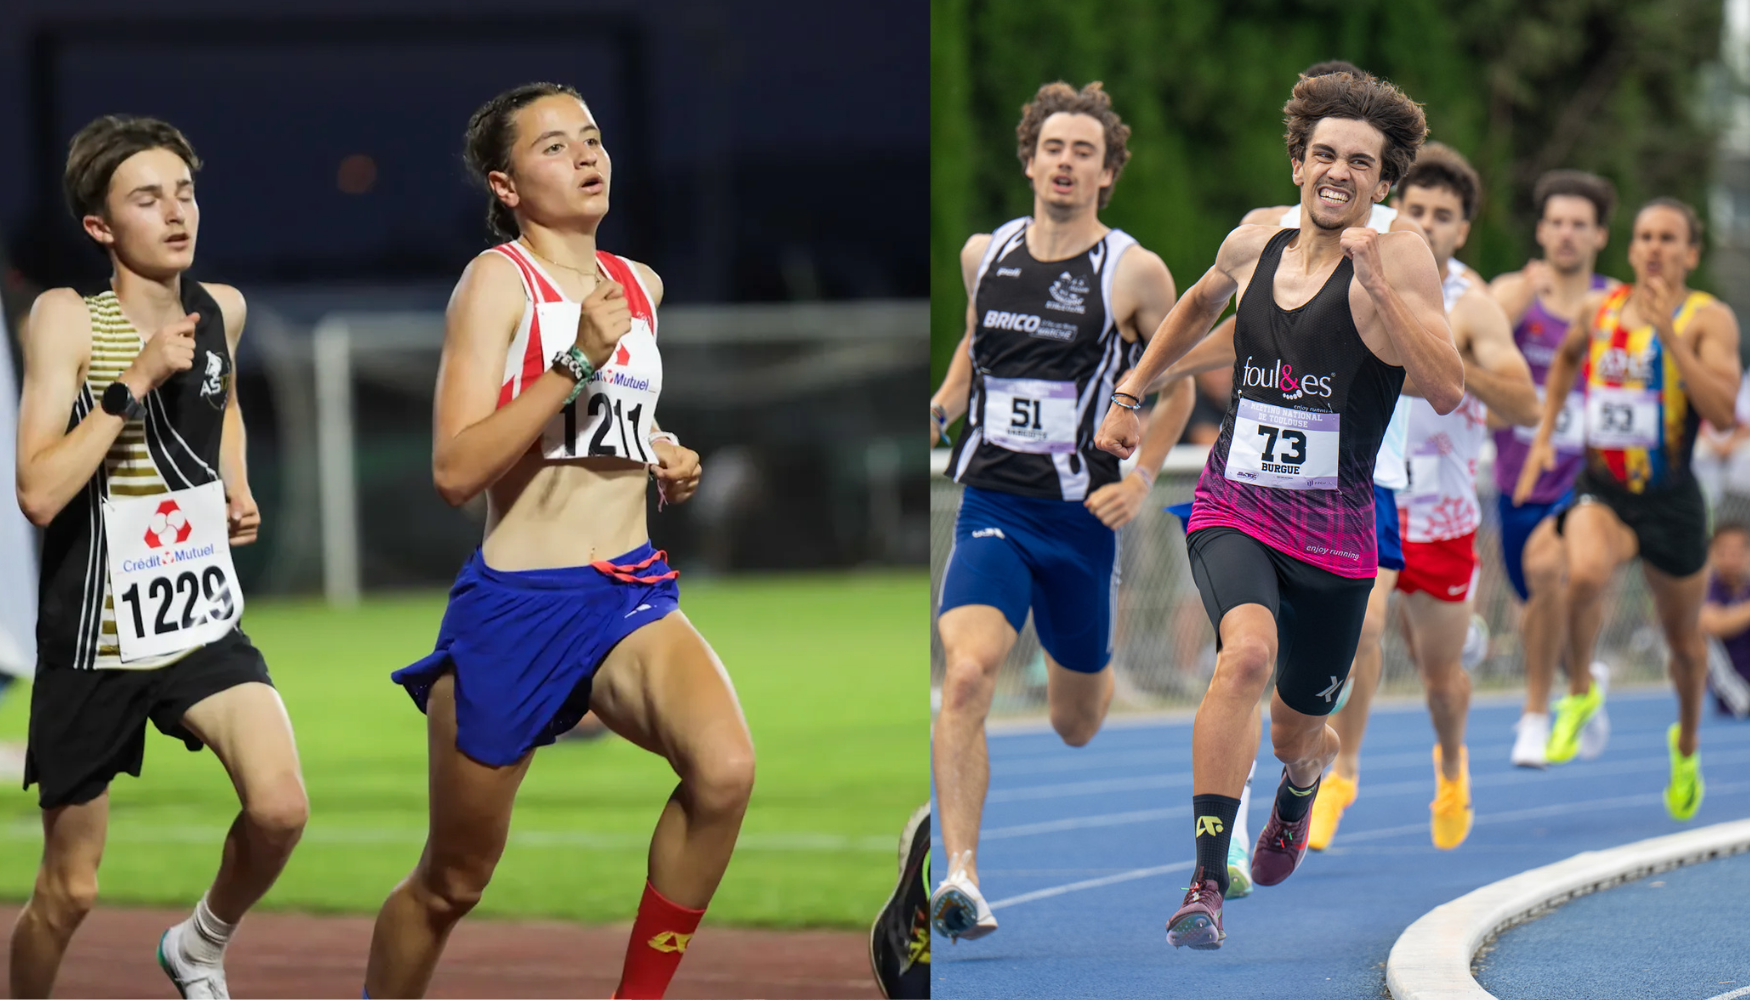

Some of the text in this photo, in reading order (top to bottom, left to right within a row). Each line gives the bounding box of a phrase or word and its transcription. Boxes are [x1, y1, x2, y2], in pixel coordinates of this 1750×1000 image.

[983, 309, 1041, 333] BRICO
[613, 372, 650, 391] Mutuel
[1011, 397, 1042, 430] 51
[1250, 402, 1323, 422] MEETING NATIONAL
[1258, 412, 1308, 428] DE TOULOUSE
[560, 392, 649, 462] 1211
[1258, 424, 1307, 466] 73
[1261, 462, 1300, 475] BURGUE
[123, 544, 215, 572] Crédit Mutuel
[1306, 545, 1360, 561] enjoy running
[121, 565, 235, 639] 1229
